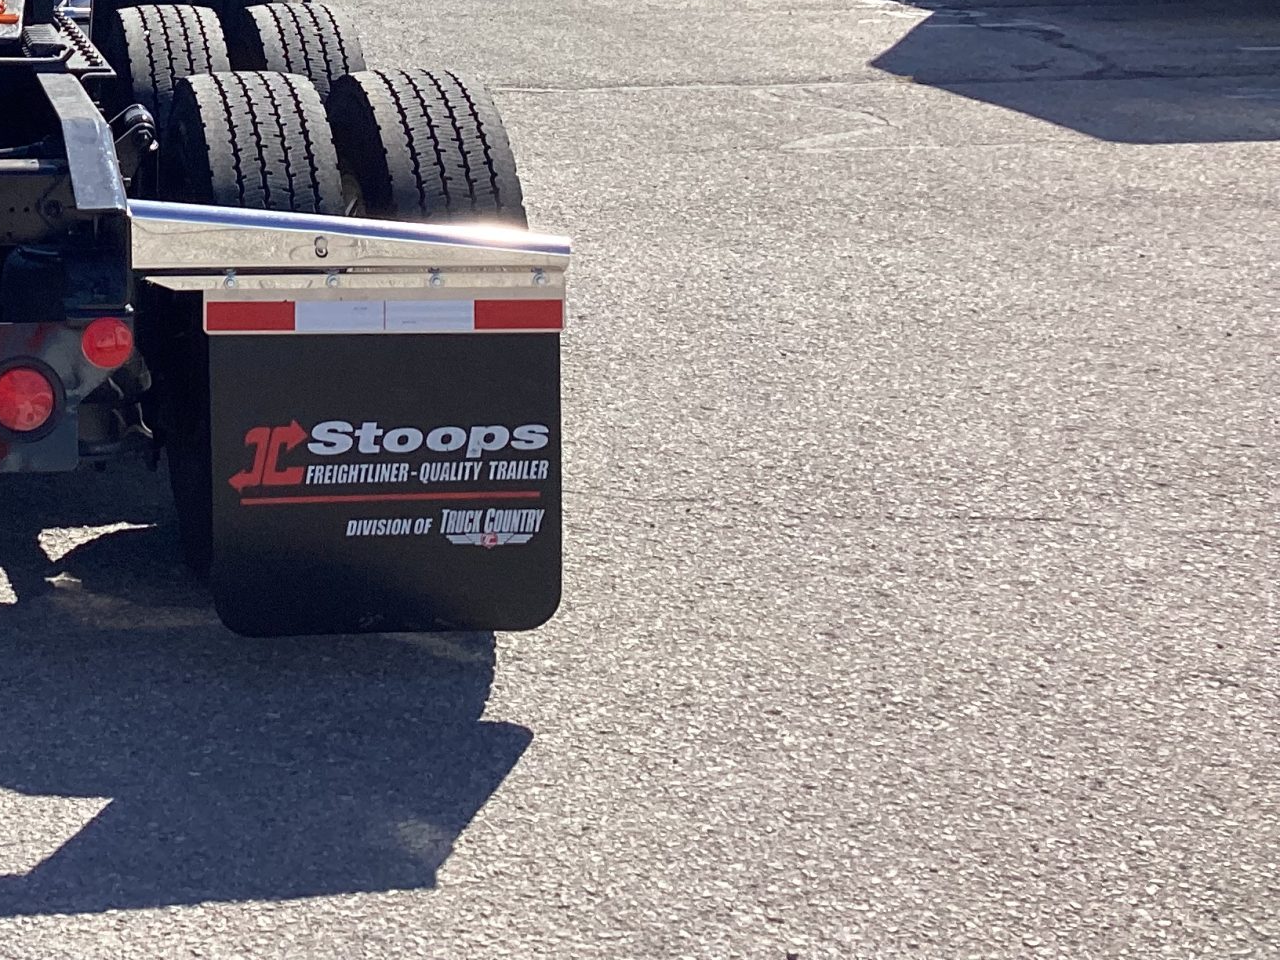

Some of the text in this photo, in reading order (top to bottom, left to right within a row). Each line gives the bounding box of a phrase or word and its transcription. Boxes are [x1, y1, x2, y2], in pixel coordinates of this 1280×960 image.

[307, 420, 550, 458] Stoops
[488, 460, 550, 480] TRAILER
[346, 518, 433, 537] DIVISION OF
[440, 508, 545, 534] TRUCK COUNTRY
